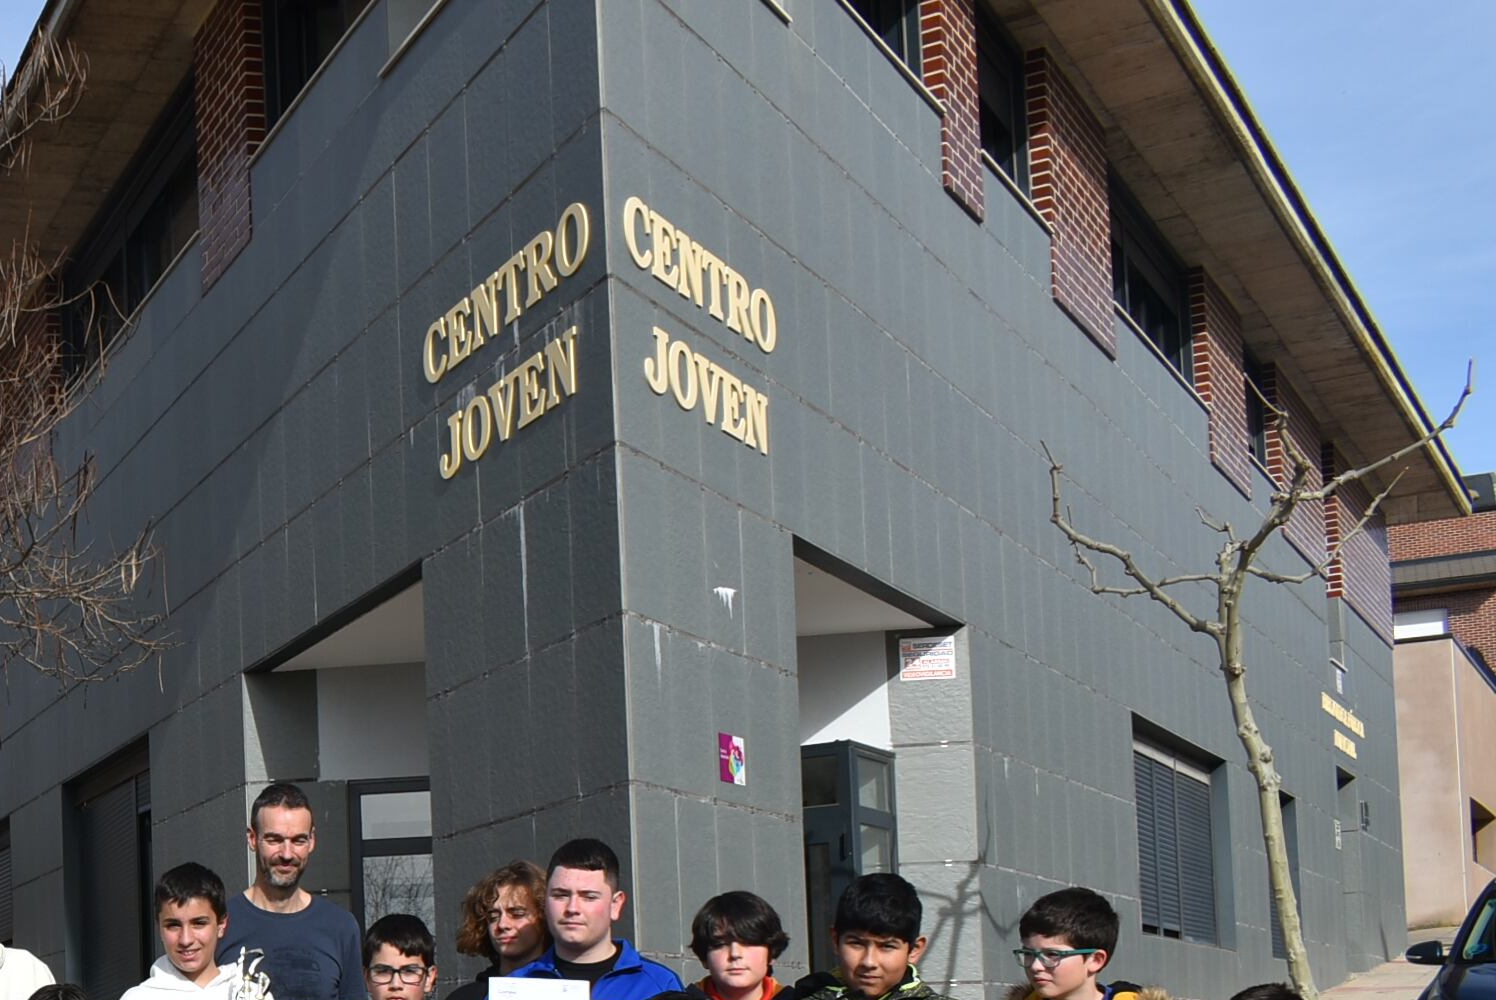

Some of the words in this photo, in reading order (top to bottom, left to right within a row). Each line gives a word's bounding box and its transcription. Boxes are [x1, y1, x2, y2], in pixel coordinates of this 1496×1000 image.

[423, 203, 592, 383] CENTRO
[623, 196, 778, 353] CENTRO
[439, 326, 579, 479] JOVEN
[644, 326, 769, 455] JOVEN
